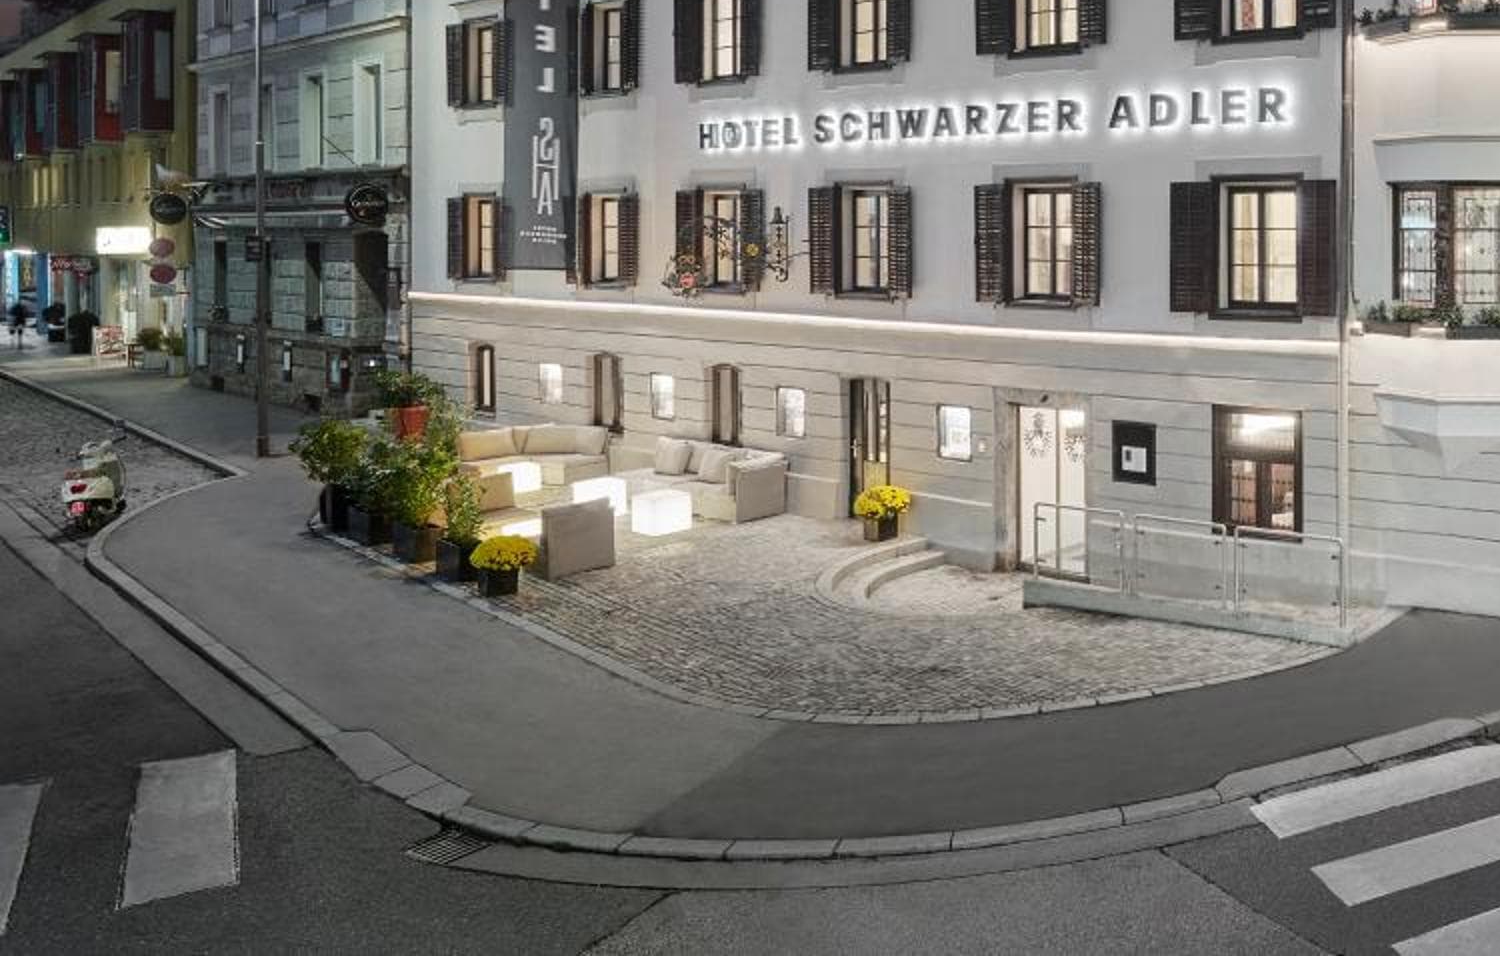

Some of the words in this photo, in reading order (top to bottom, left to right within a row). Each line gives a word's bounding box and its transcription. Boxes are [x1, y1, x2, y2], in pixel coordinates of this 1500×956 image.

[699, 116, 800, 150] HOTEL
[813, 98, 1083, 143] SCHWARZER
[1108, 87, 1289, 129] ADLER
